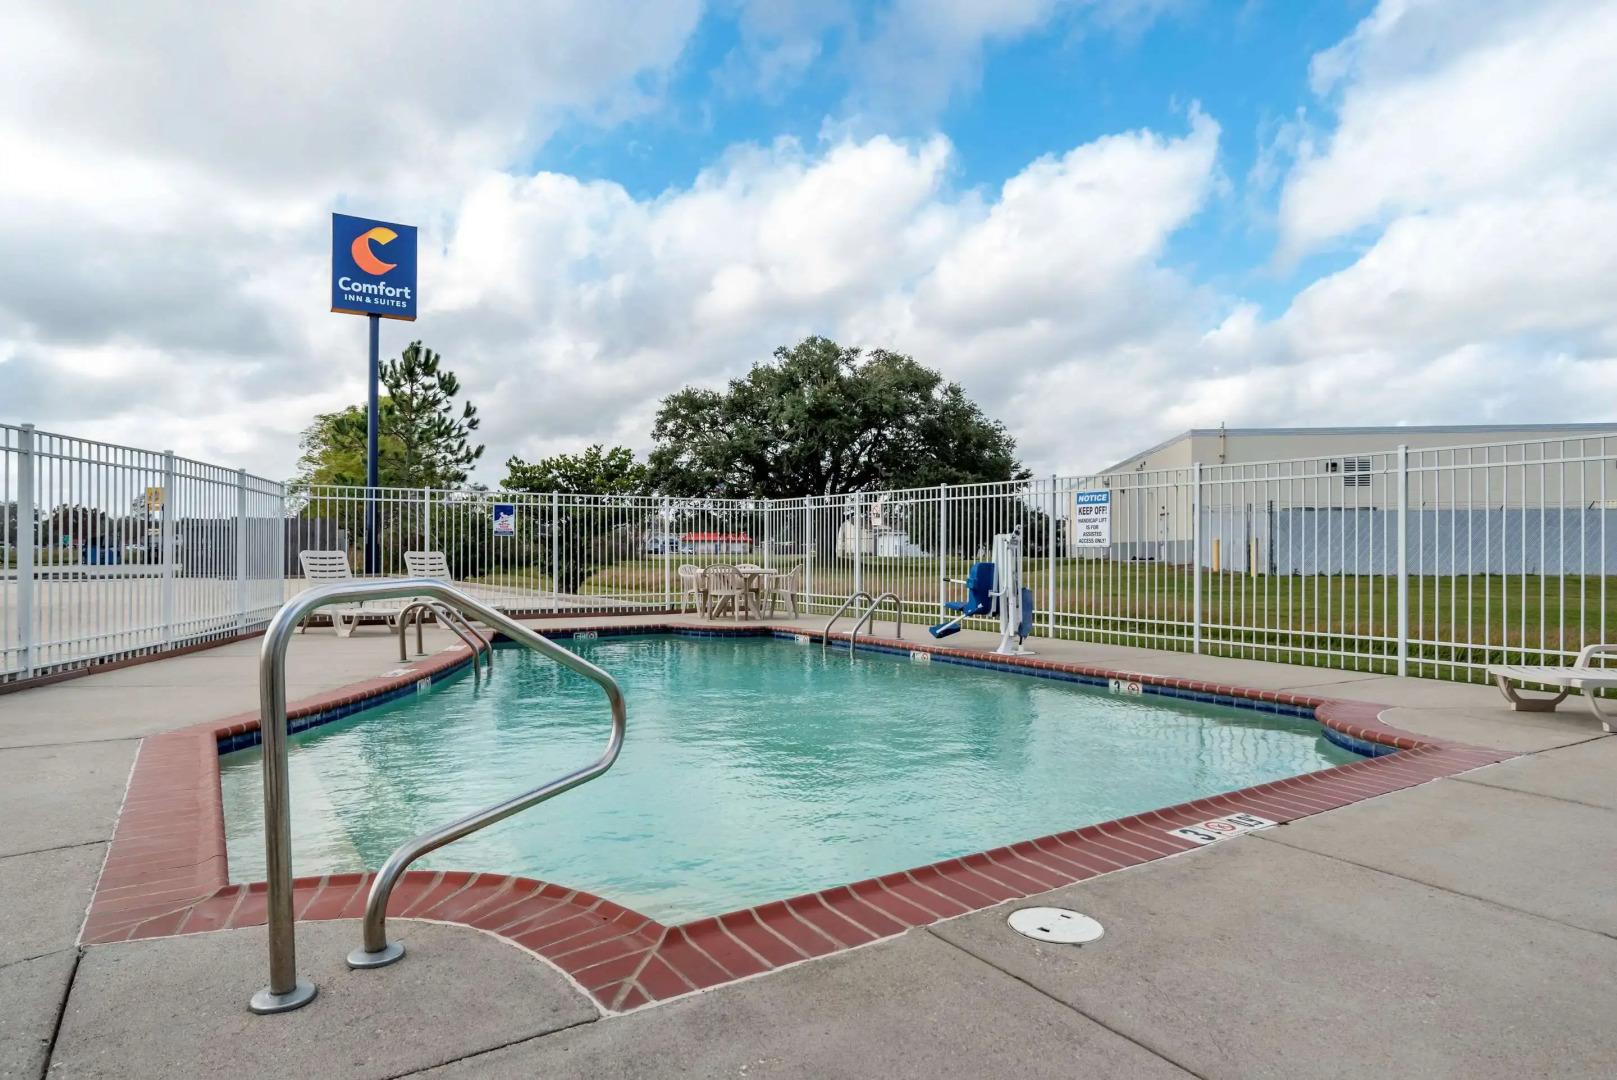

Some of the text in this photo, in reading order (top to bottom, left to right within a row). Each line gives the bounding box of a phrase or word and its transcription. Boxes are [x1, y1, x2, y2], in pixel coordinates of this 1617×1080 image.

[338, 276, 411, 299] Comfort
[344, 293, 407, 308] INN & SUITES
[1078, 493, 1108, 503] NOTICE
[1078, 505, 1108, 515] KEEP OFF!
